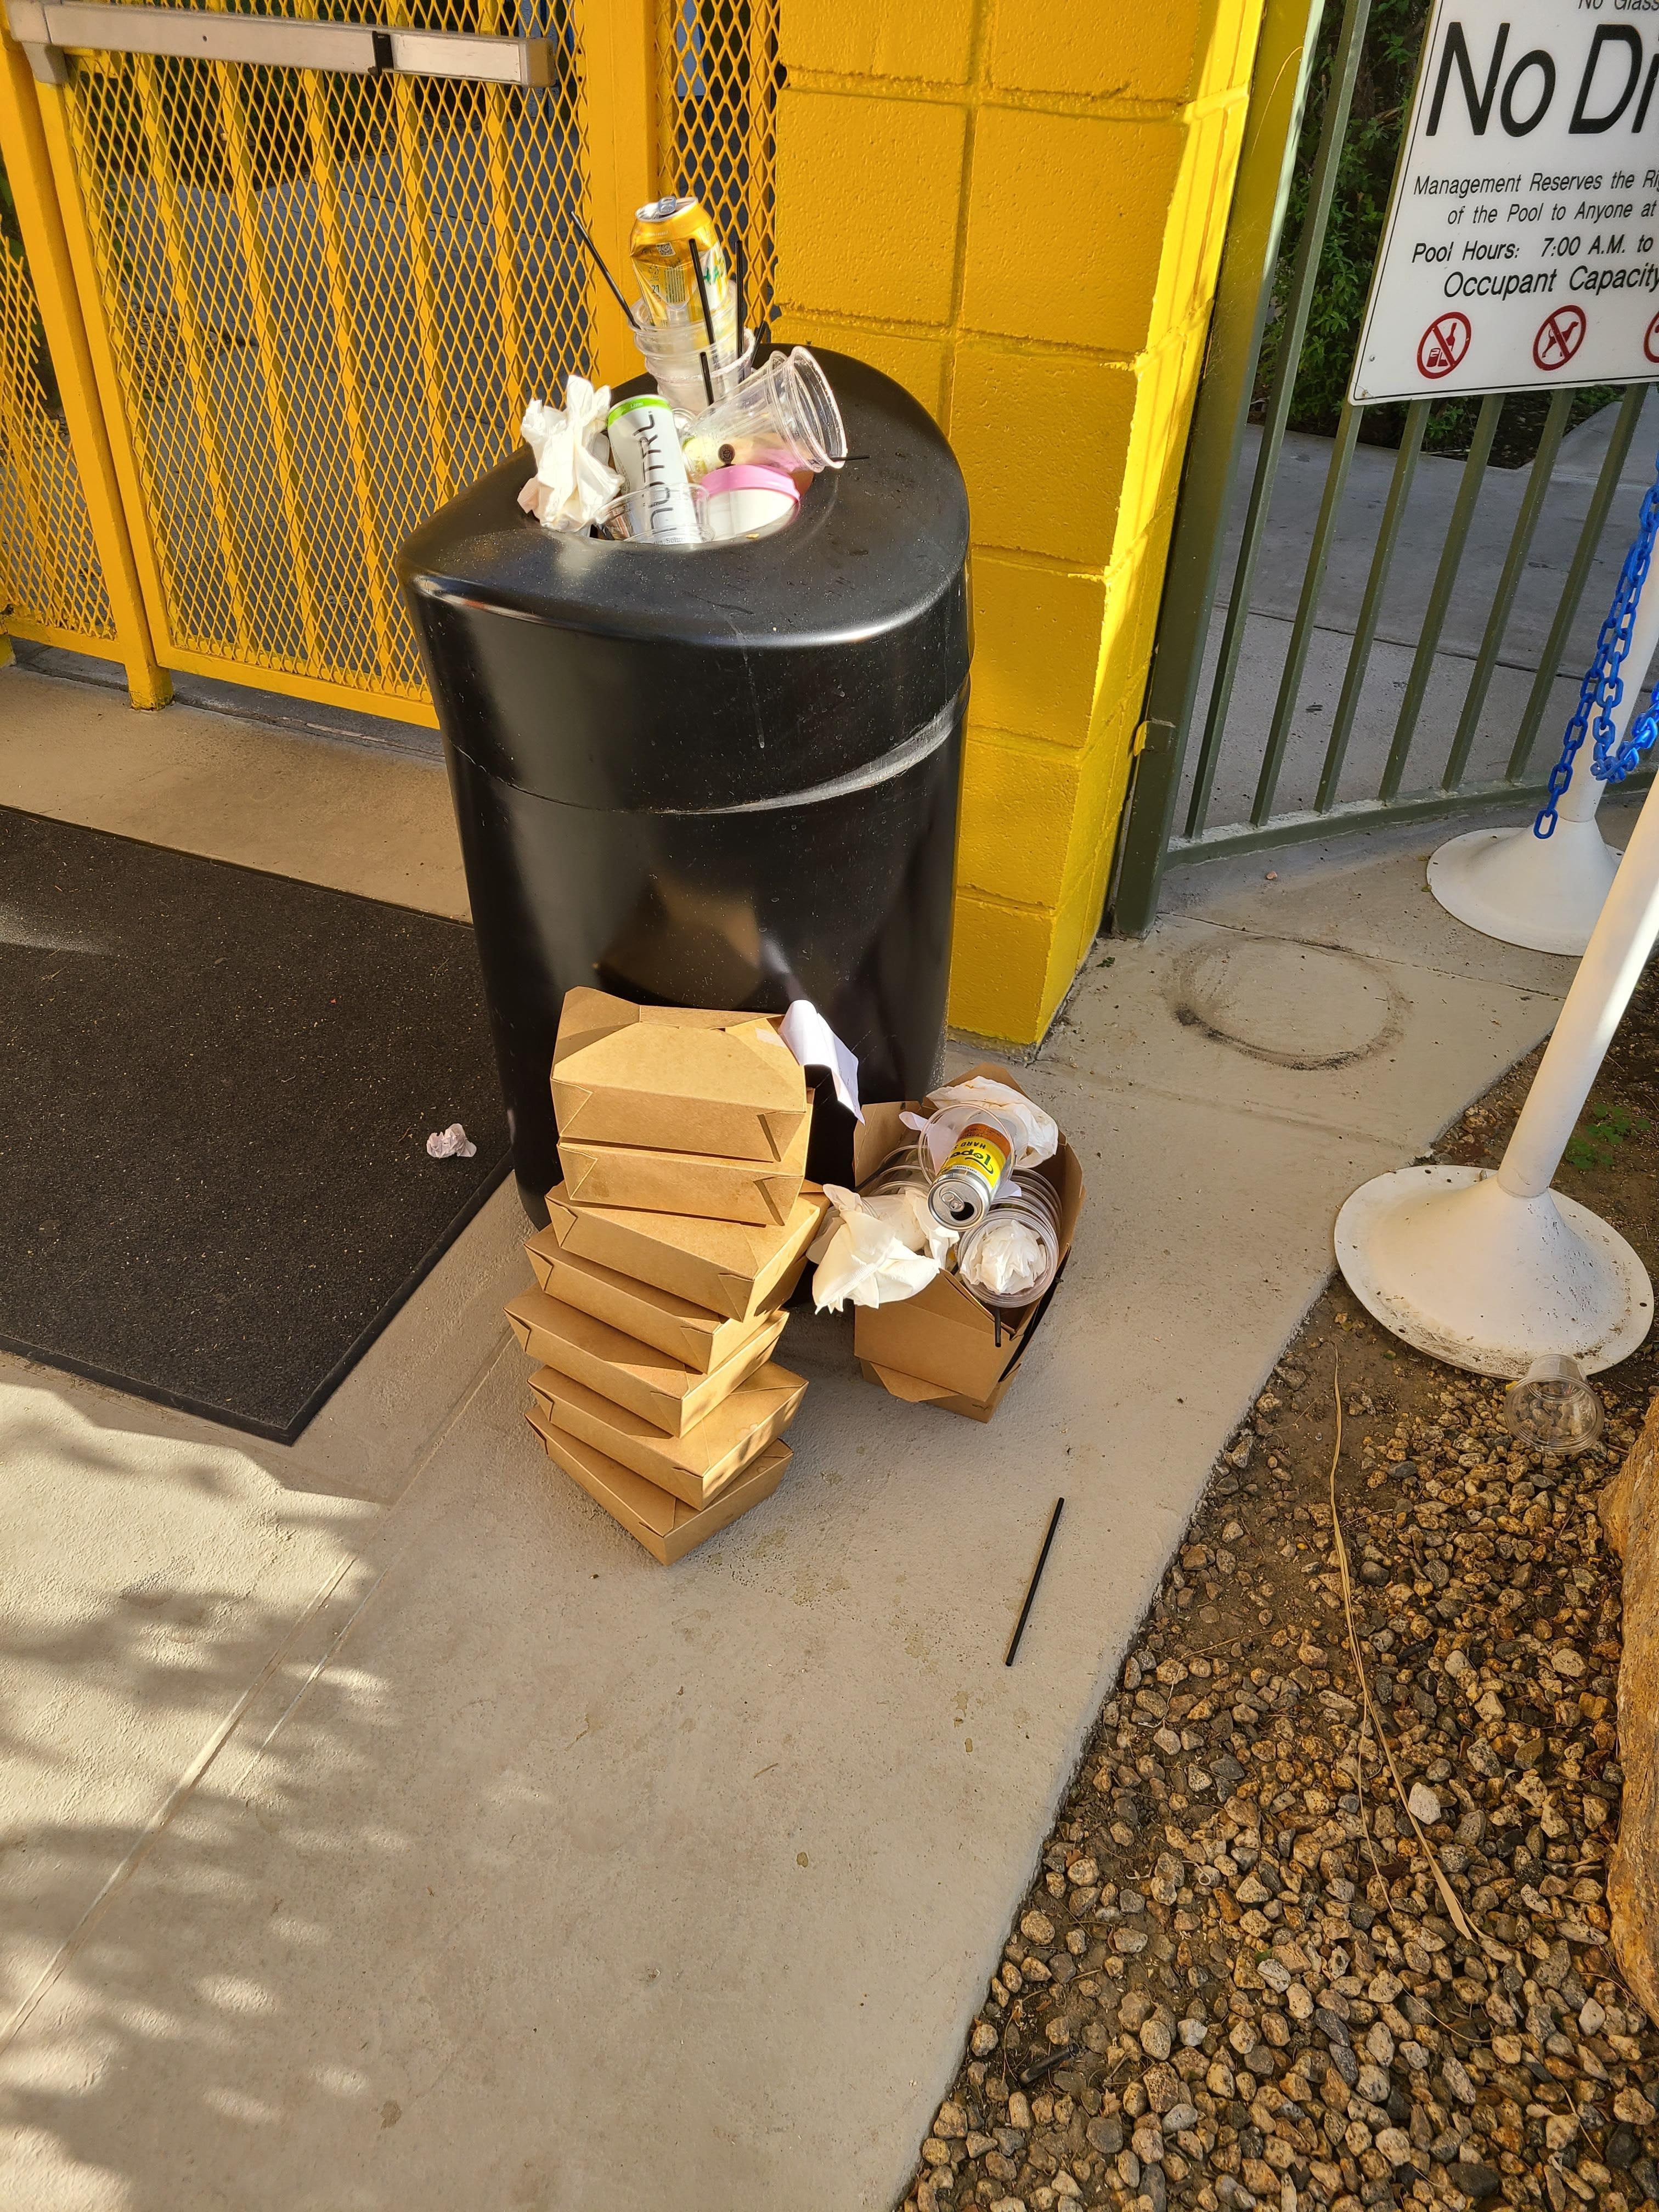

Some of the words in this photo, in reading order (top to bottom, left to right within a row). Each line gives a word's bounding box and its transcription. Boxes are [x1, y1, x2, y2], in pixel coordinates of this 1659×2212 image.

[1426, 22, 1556, 137] No
[1413, 174, 1521, 198] Management
[1529, 173, 1602, 191] Reserves
[1610, 170, 1634, 189] the
[1447, 205, 1465, 224] of
[1472, 205, 1497, 223] the
[1507, 202, 1544, 222] Pool
[1551, 204, 1566, 221] to
[1574, 201, 1633, 224] Anyone
[1641, 200, 1657, 217] at
[1412, 241, 1454, 263] Pool
[1462, 240, 1520, 261] Hours:
[1541, 236, 1581, 257] 7:00
[1588, 234, 1625, 255] A.M.
[1637, 234, 1654, 252] to
[1444, 269, 1557, 301] Occupant
[960, 1141, 986, 1149] HARD
